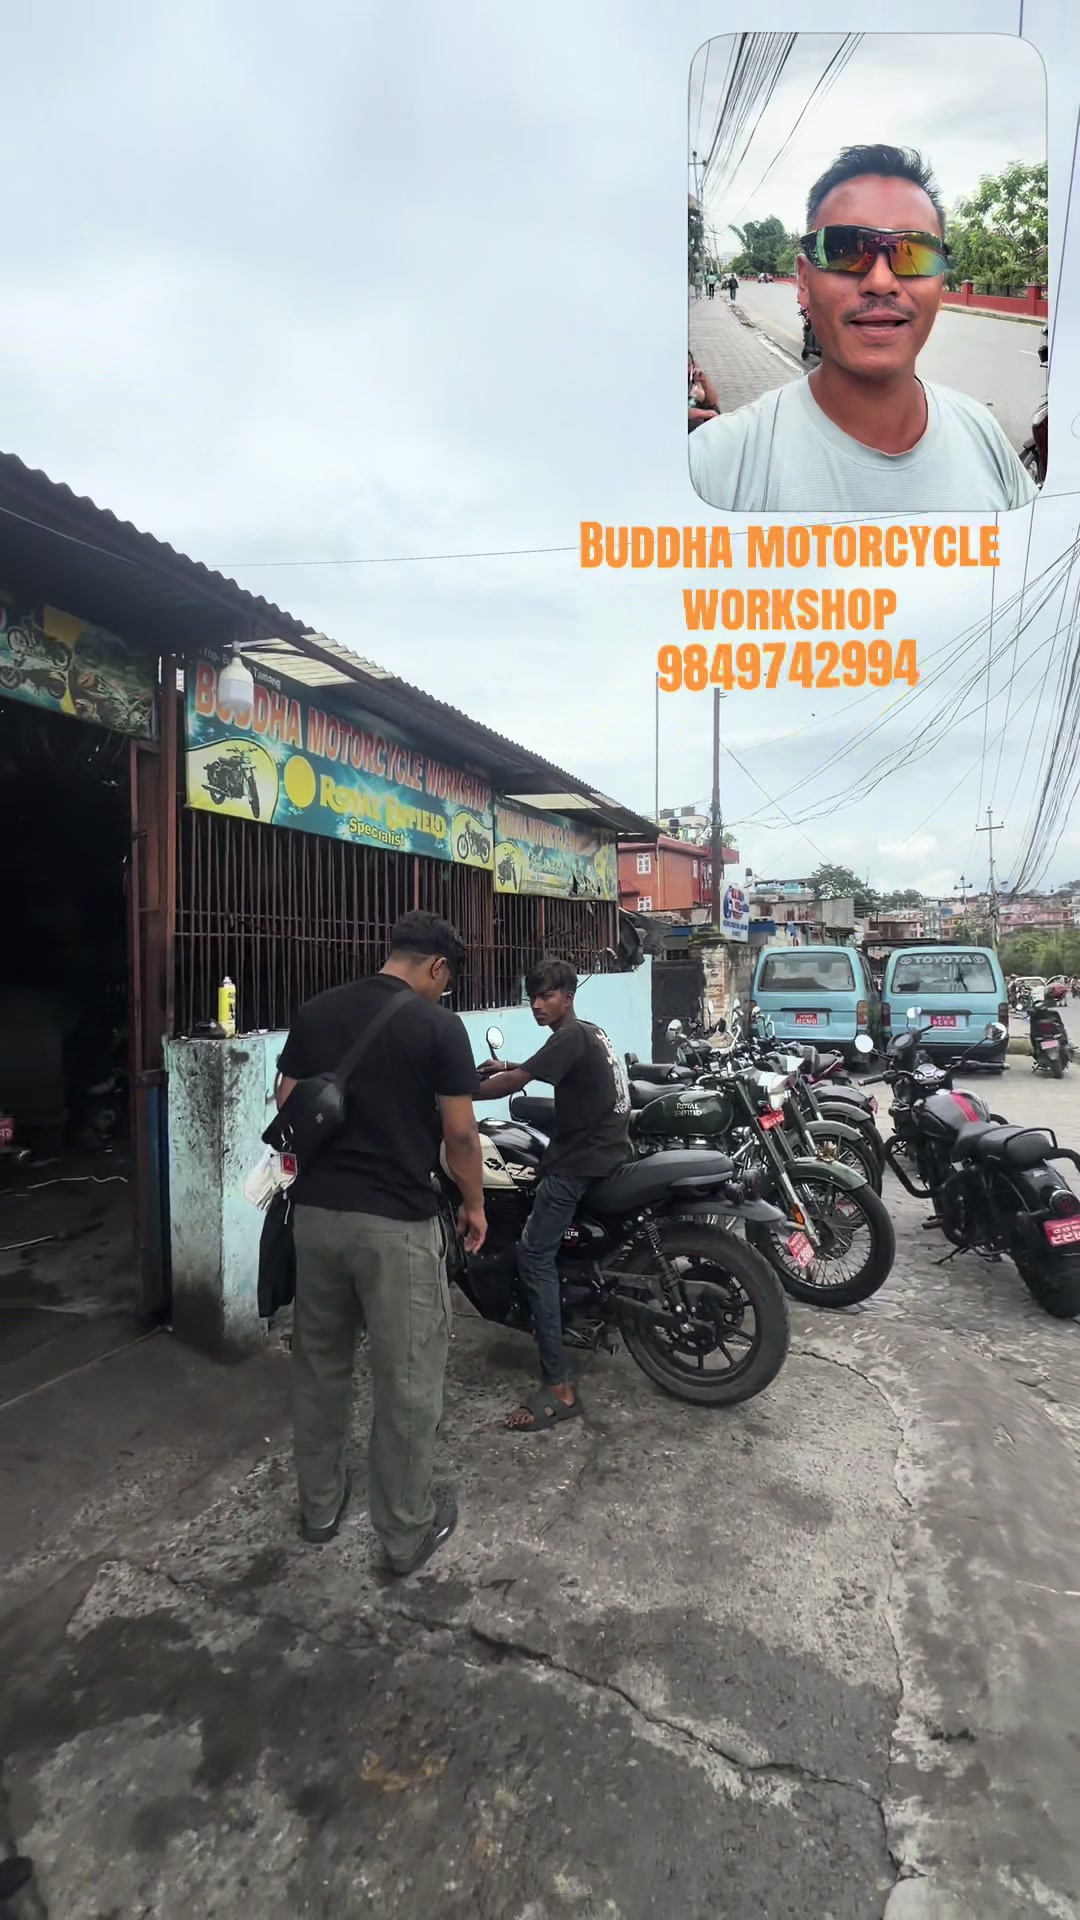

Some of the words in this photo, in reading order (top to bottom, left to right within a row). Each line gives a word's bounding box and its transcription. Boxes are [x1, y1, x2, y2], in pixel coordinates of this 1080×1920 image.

[307, 707, 423, 792] MOTORCYCLE
[425, 759, 492, 814] WORKSHOP
[349, 816, 406, 847] Specialist
[913, 956, 972, 964] TOYOTA
